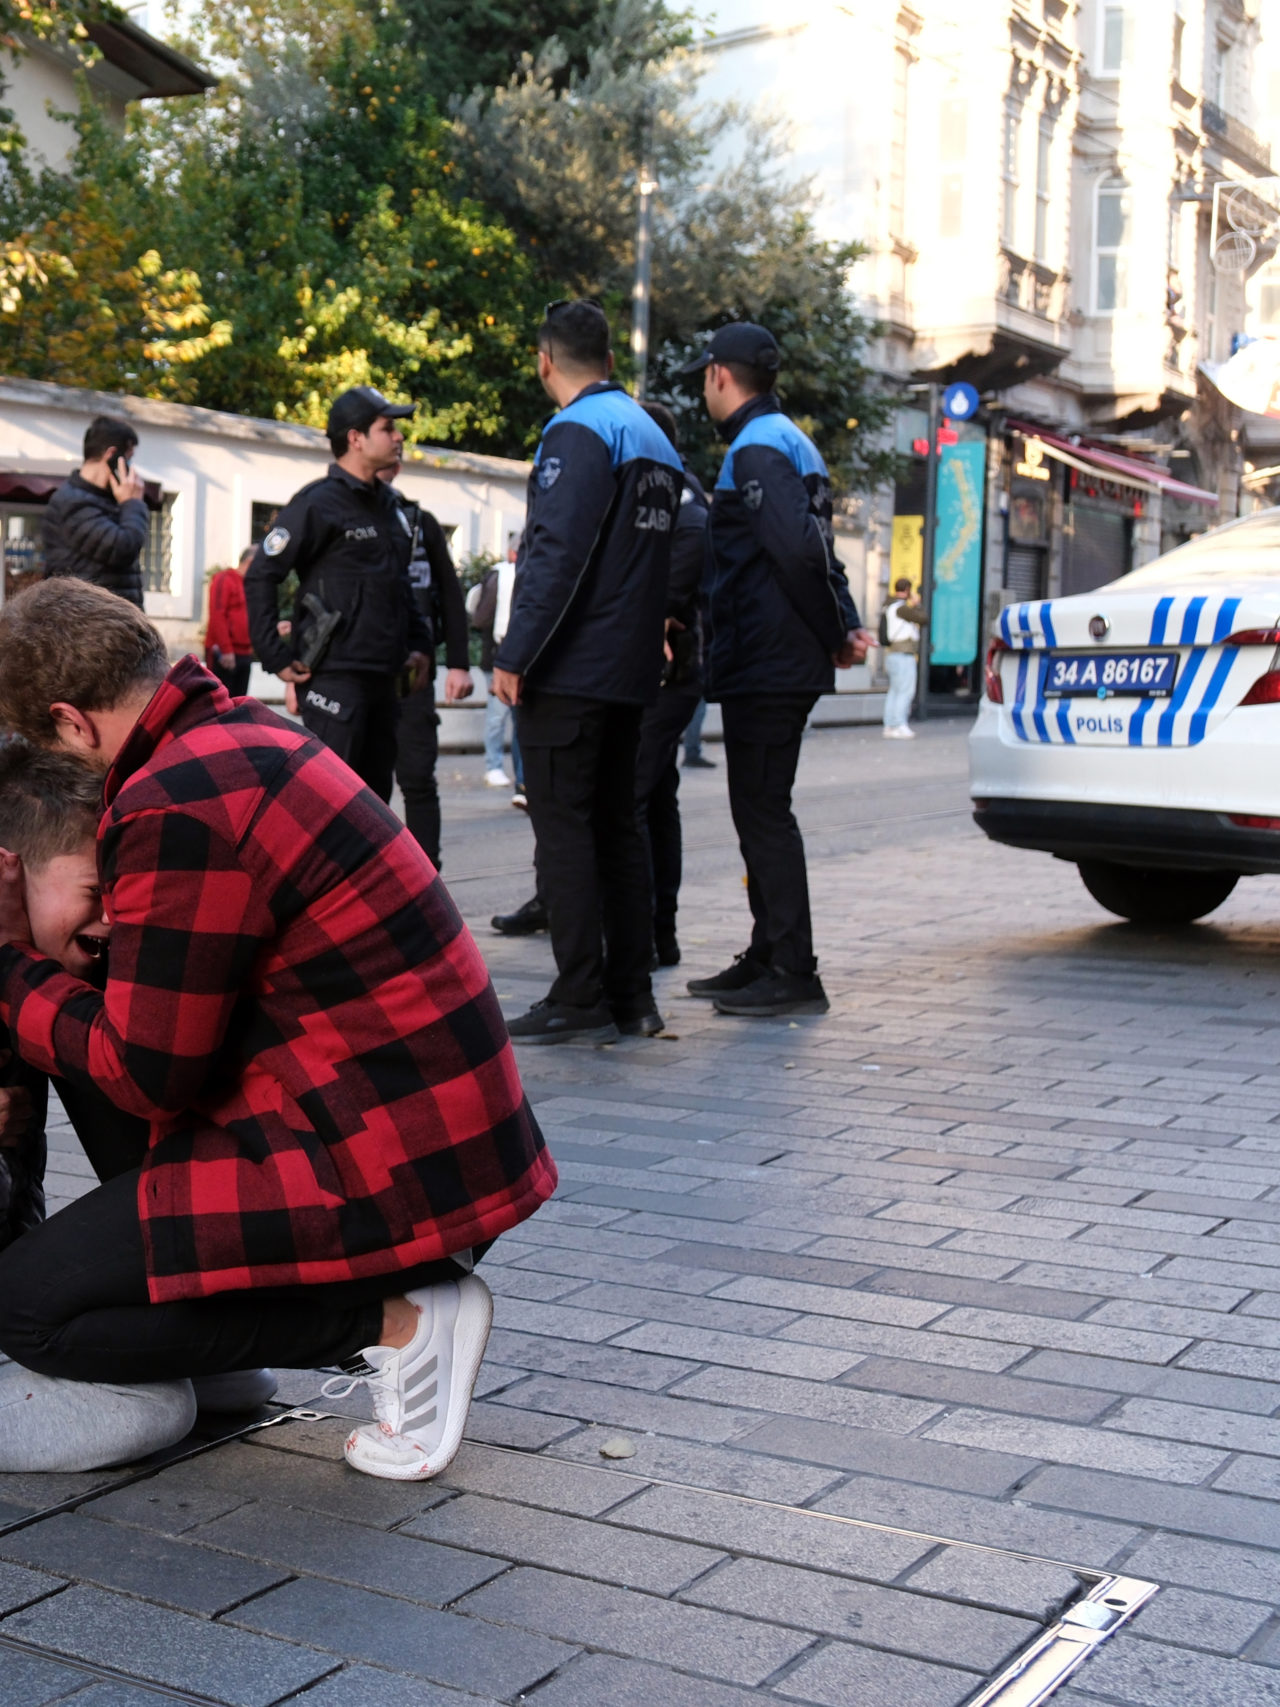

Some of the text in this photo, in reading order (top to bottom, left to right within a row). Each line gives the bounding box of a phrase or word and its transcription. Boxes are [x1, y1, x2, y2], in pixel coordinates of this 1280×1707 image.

[1053, 657, 1169, 686] 34 A 86167
[1076, 714, 1124, 733] POLİS
